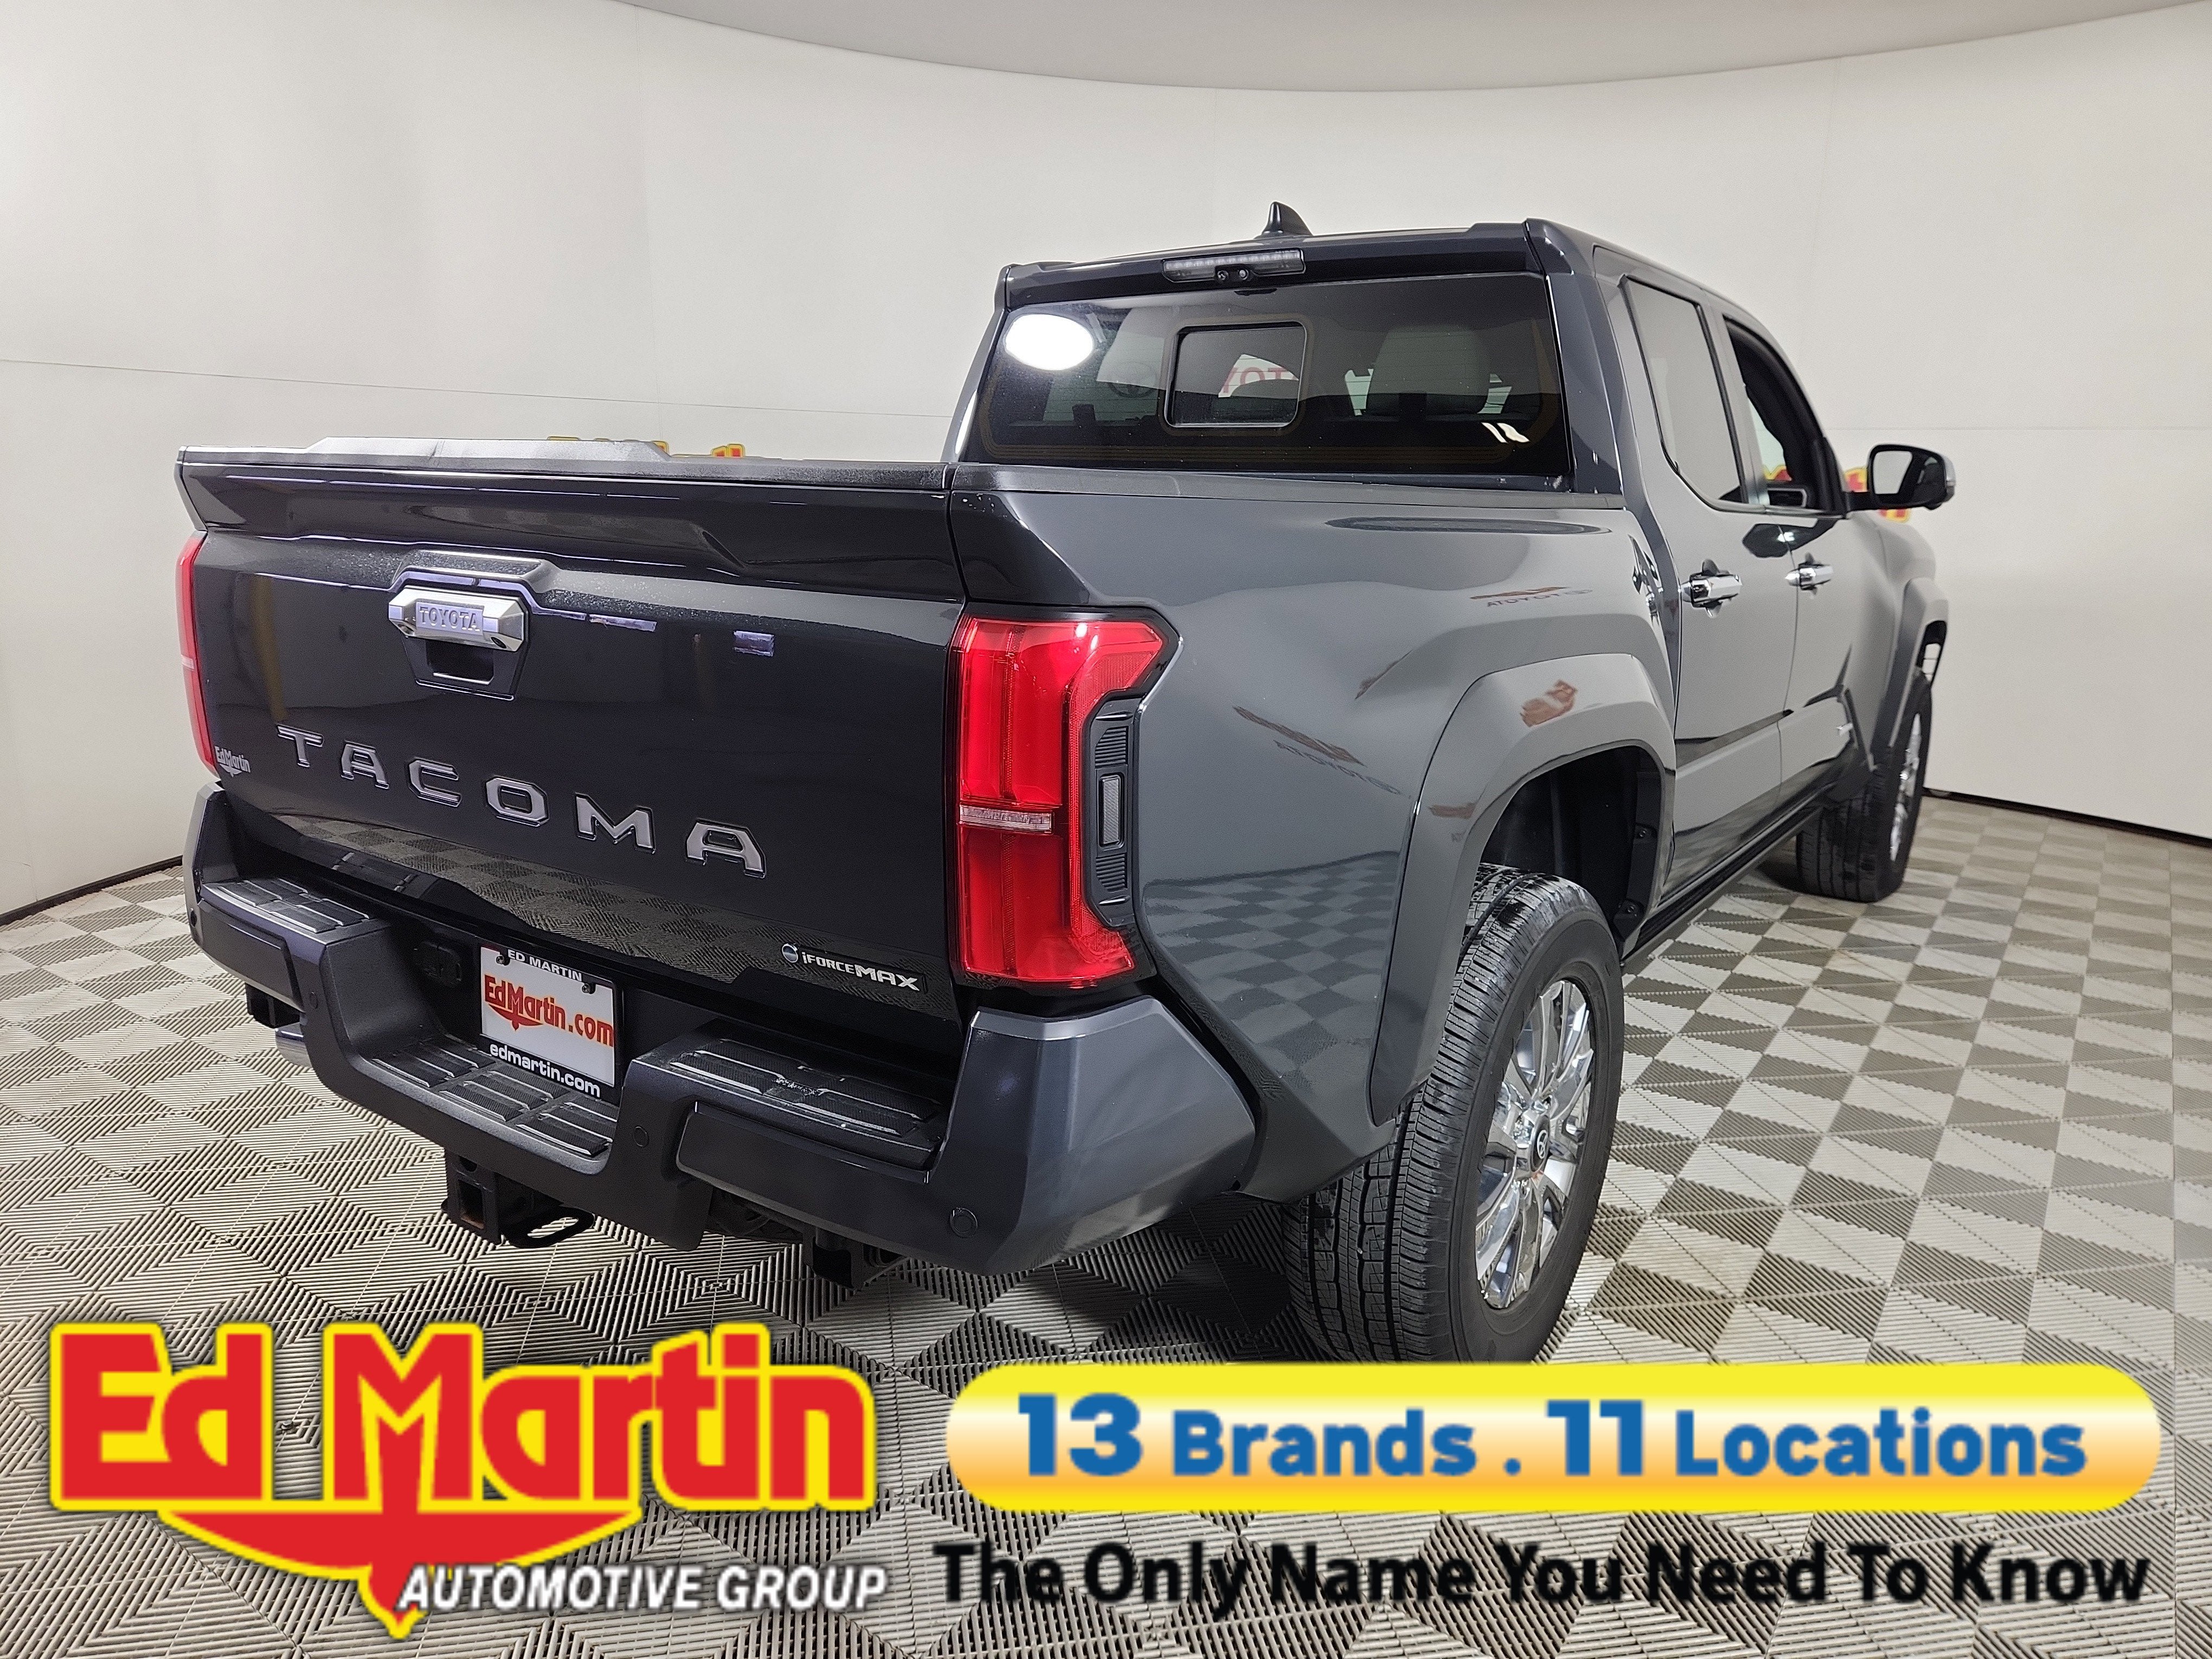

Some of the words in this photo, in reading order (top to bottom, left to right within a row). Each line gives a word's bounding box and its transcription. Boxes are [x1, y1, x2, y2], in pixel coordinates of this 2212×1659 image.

[420, 606, 481, 632] TOYOTA
[275, 724, 766, 878] TACOMA
[507, 949, 525, 962] ED
[529, 956, 582, 982] MARTIN
[490, 1043, 600, 1098] edmartin.com
